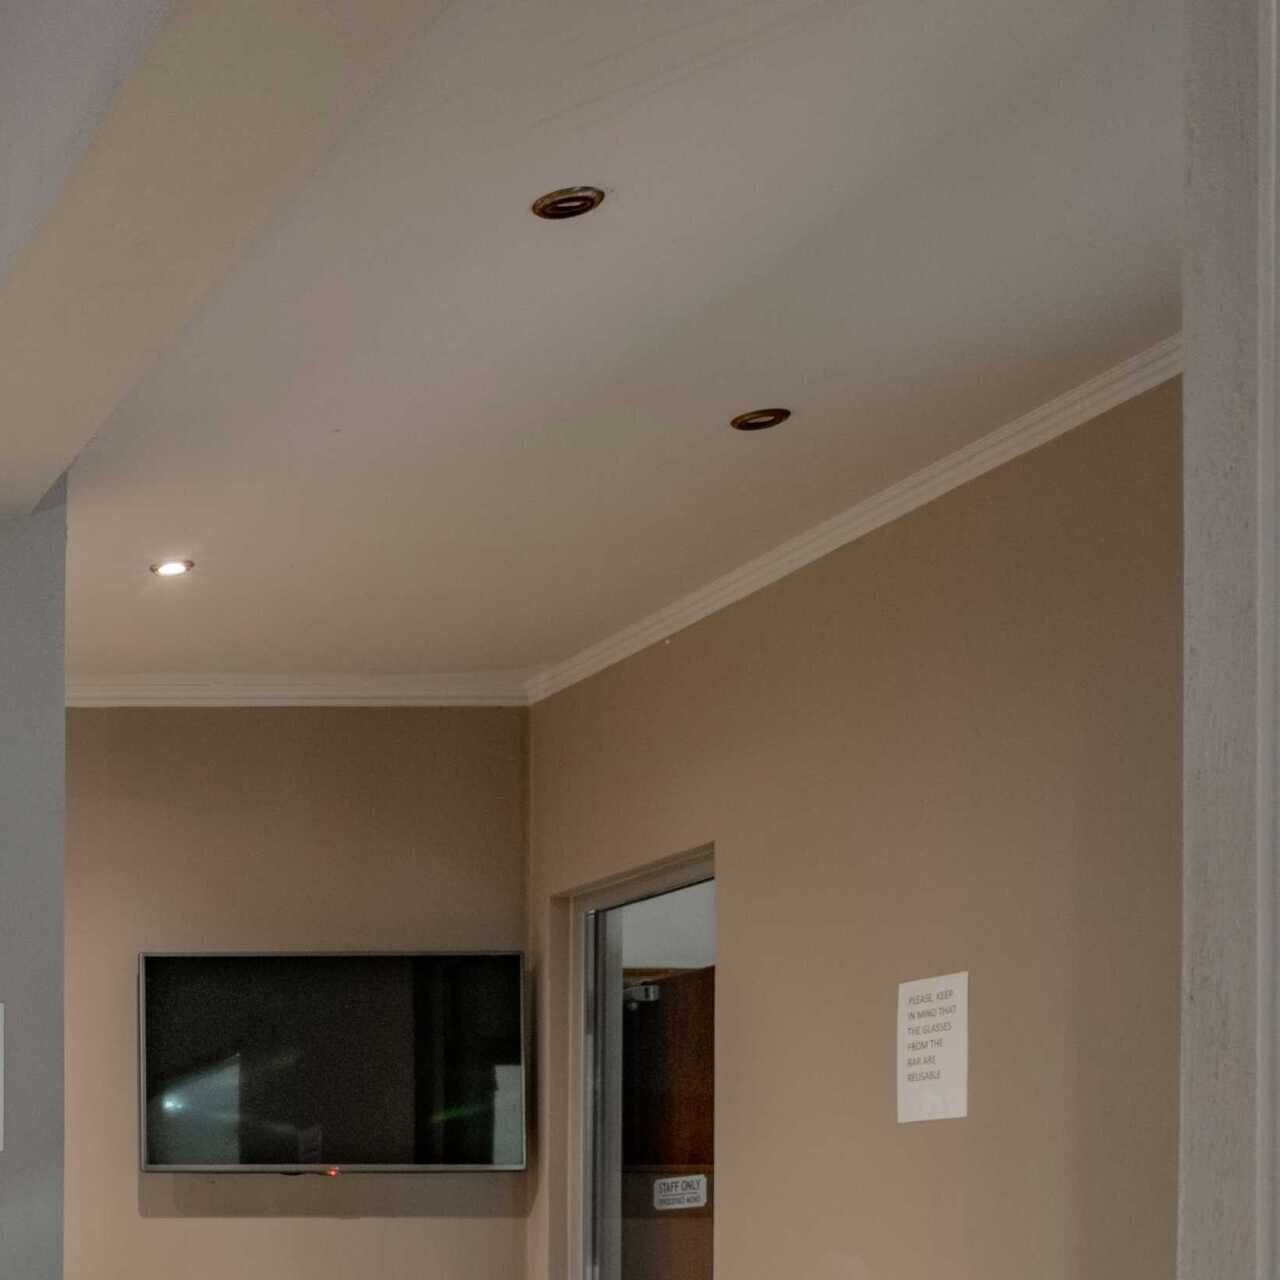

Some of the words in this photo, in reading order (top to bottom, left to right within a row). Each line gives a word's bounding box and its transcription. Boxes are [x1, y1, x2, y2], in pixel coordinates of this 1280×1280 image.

[936, 990, 953, 1000] KEEP
[917, 1008, 937, 1019] MIND
[938, 1004, 956, 1016] THAT
[908, 1026, 920, 1035] THE
[922, 1022, 952, 1034] GLASSES
[908, 1041, 928, 1051] FROM
[930, 1038, 943, 1048] THE
[908, 1070, 940, 1082] REUSABLE
[658, 1181, 680, 1194] STAFF
[681, 1179, 701, 1191] ONLY
